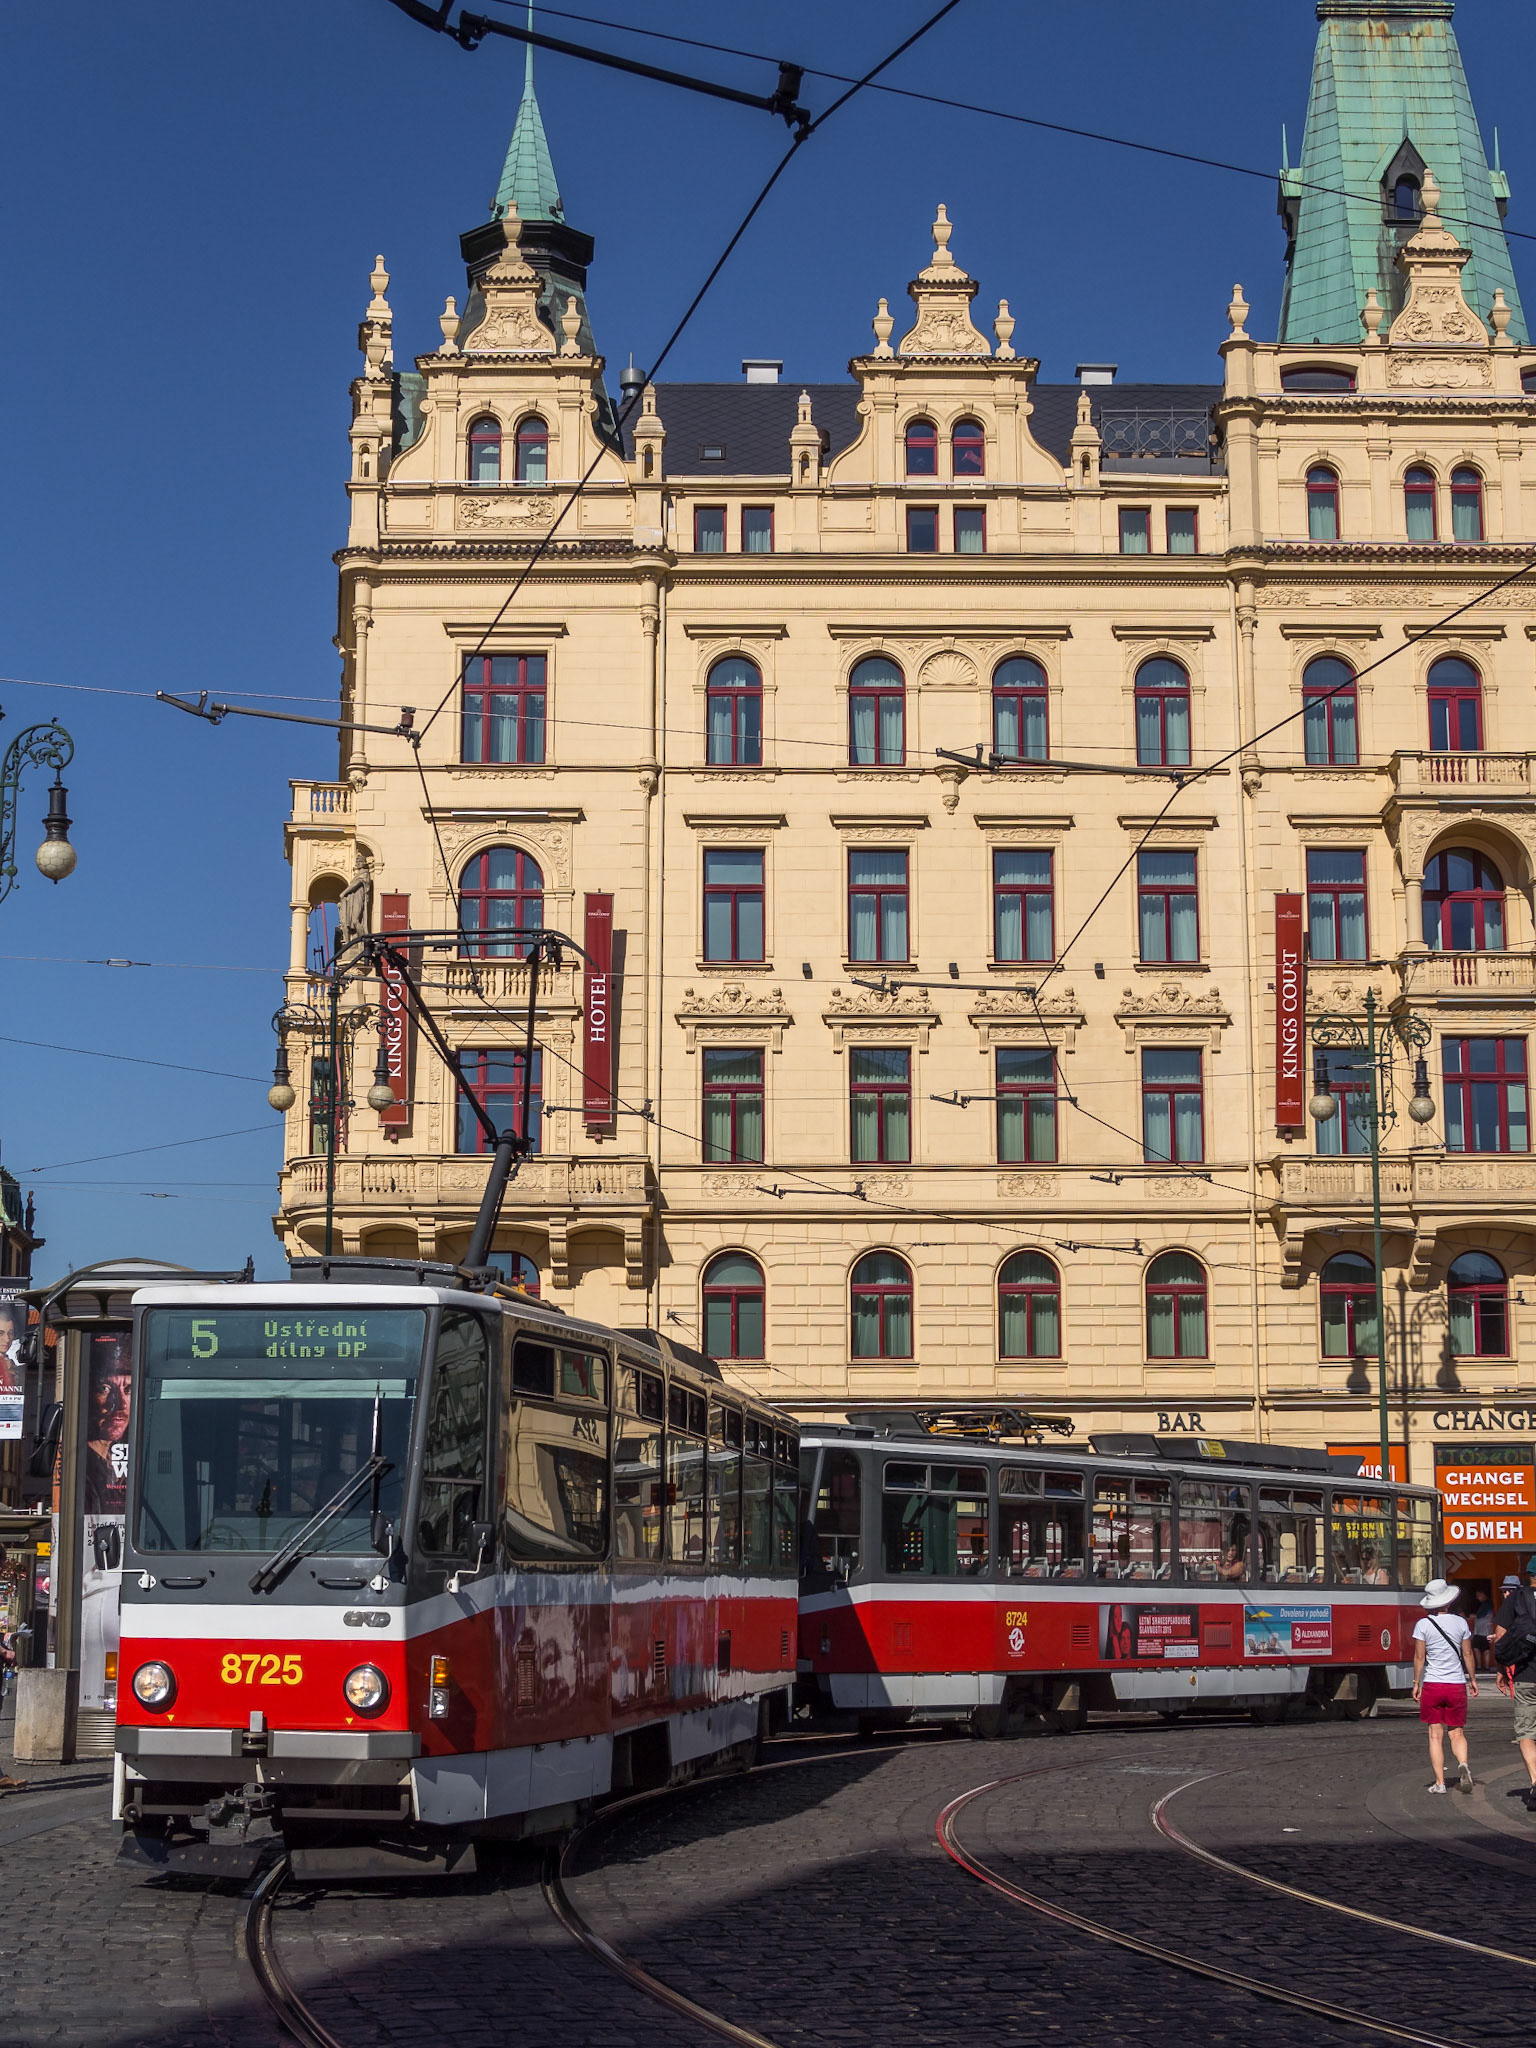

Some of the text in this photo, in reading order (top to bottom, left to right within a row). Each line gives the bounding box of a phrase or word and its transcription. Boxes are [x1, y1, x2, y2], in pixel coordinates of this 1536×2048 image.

[590, 973, 606, 1043] HOTEL
[1282, 949, 1298, 1079] KINGS COURT
[386, 963, 402, 1078] KINGS COU
[264, 1319, 368, 1337] Ústřední
[191, 1320, 218, 1358] 5
[266, 1340, 368, 1358] dílny DP
[1157, 1412, 1206, 1432] BAR
[1433, 1410, 1536, 1430] CHANGE
[1445, 1472, 1524, 1485] CHANGE
[1444, 1492, 1528, 1506] WECHSEL
[1331, 1522, 1375, 1530] WSTRN
[1450, 1520, 1524, 1540] ОБМЕН
[1006, 1611, 1028, 1626] 8724
[1302, 1630, 1329, 1638] ALEXANDRIA
[221, 1653, 303, 1686] 8725
